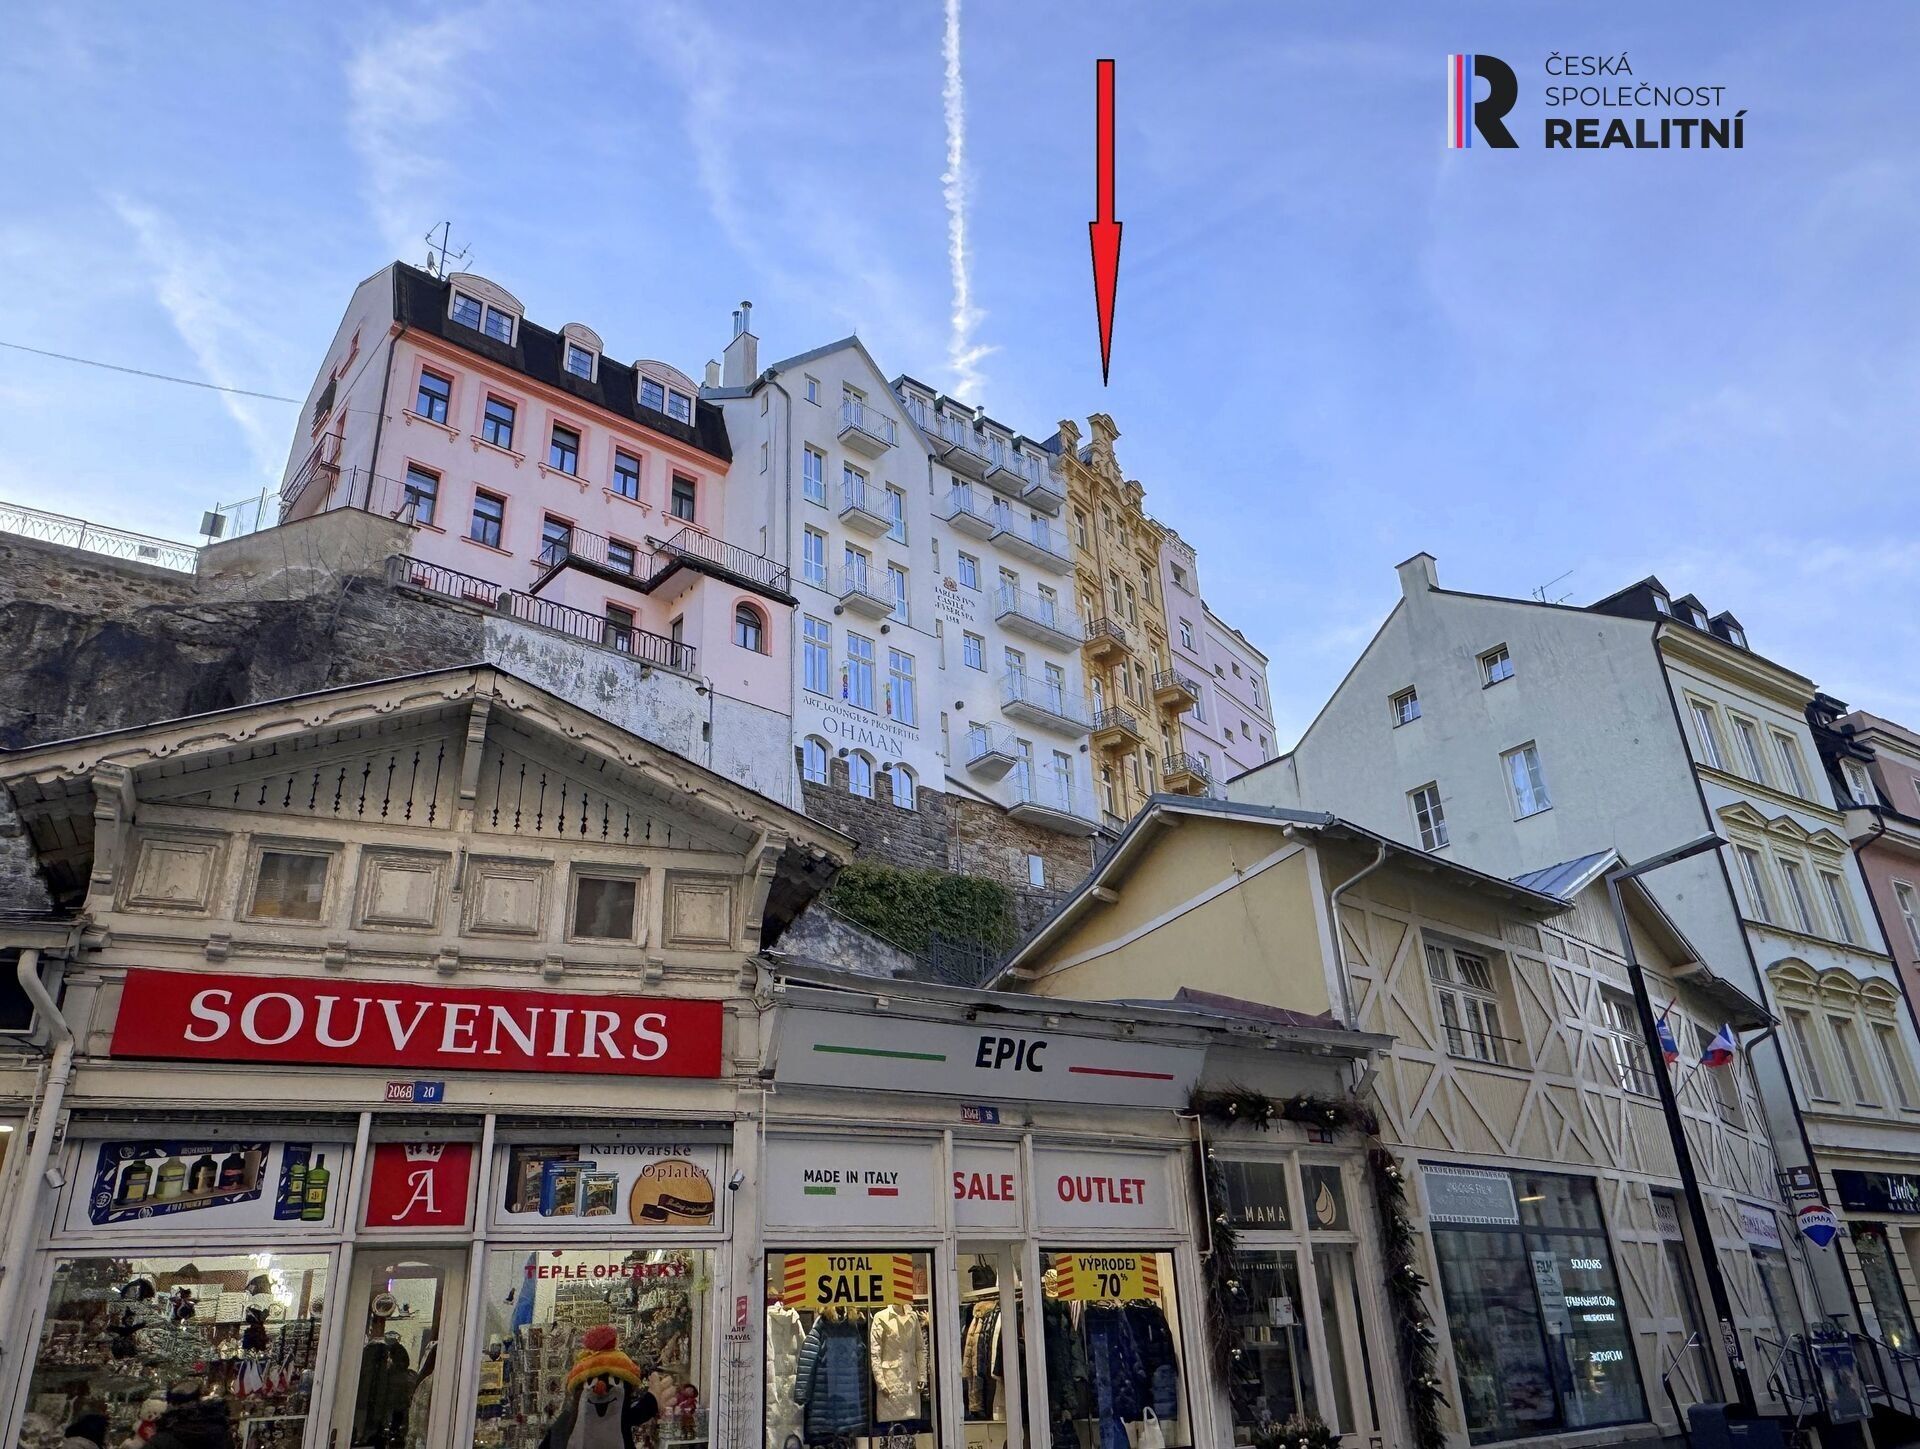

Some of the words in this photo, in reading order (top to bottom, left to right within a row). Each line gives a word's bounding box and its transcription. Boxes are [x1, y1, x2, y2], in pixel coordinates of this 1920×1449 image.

[822, 716, 903, 757] OHMAN
[183, 989, 668, 1061] SOUVENIRS
[975, 1036, 1048, 1073] EPIC
[387, 1085, 413, 1099] 2068
[423, 1086, 435, 1098] 20
[642, 1164, 710, 1182] Oplatky
[804, 1169, 840, 1184] MADE
[846, 1170, 858, 1184] IN
[864, 1171, 898, 1185] ITALY
[953, 1171, 1015, 1201] SALE
[1057, 1175, 1146, 1205] OUTLET
[1244, 1206, 1286, 1222] MAMA
[525, 1262, 587, 1279] TEPLÉ
[593, 1263, 686, 1279] OPLATKY
[828, 1256, 873, 1271] TOTAL
[1078, 1254, 1136, 1271] VÝPRODEJ
[817, 1274, 884, 1304] SALE
